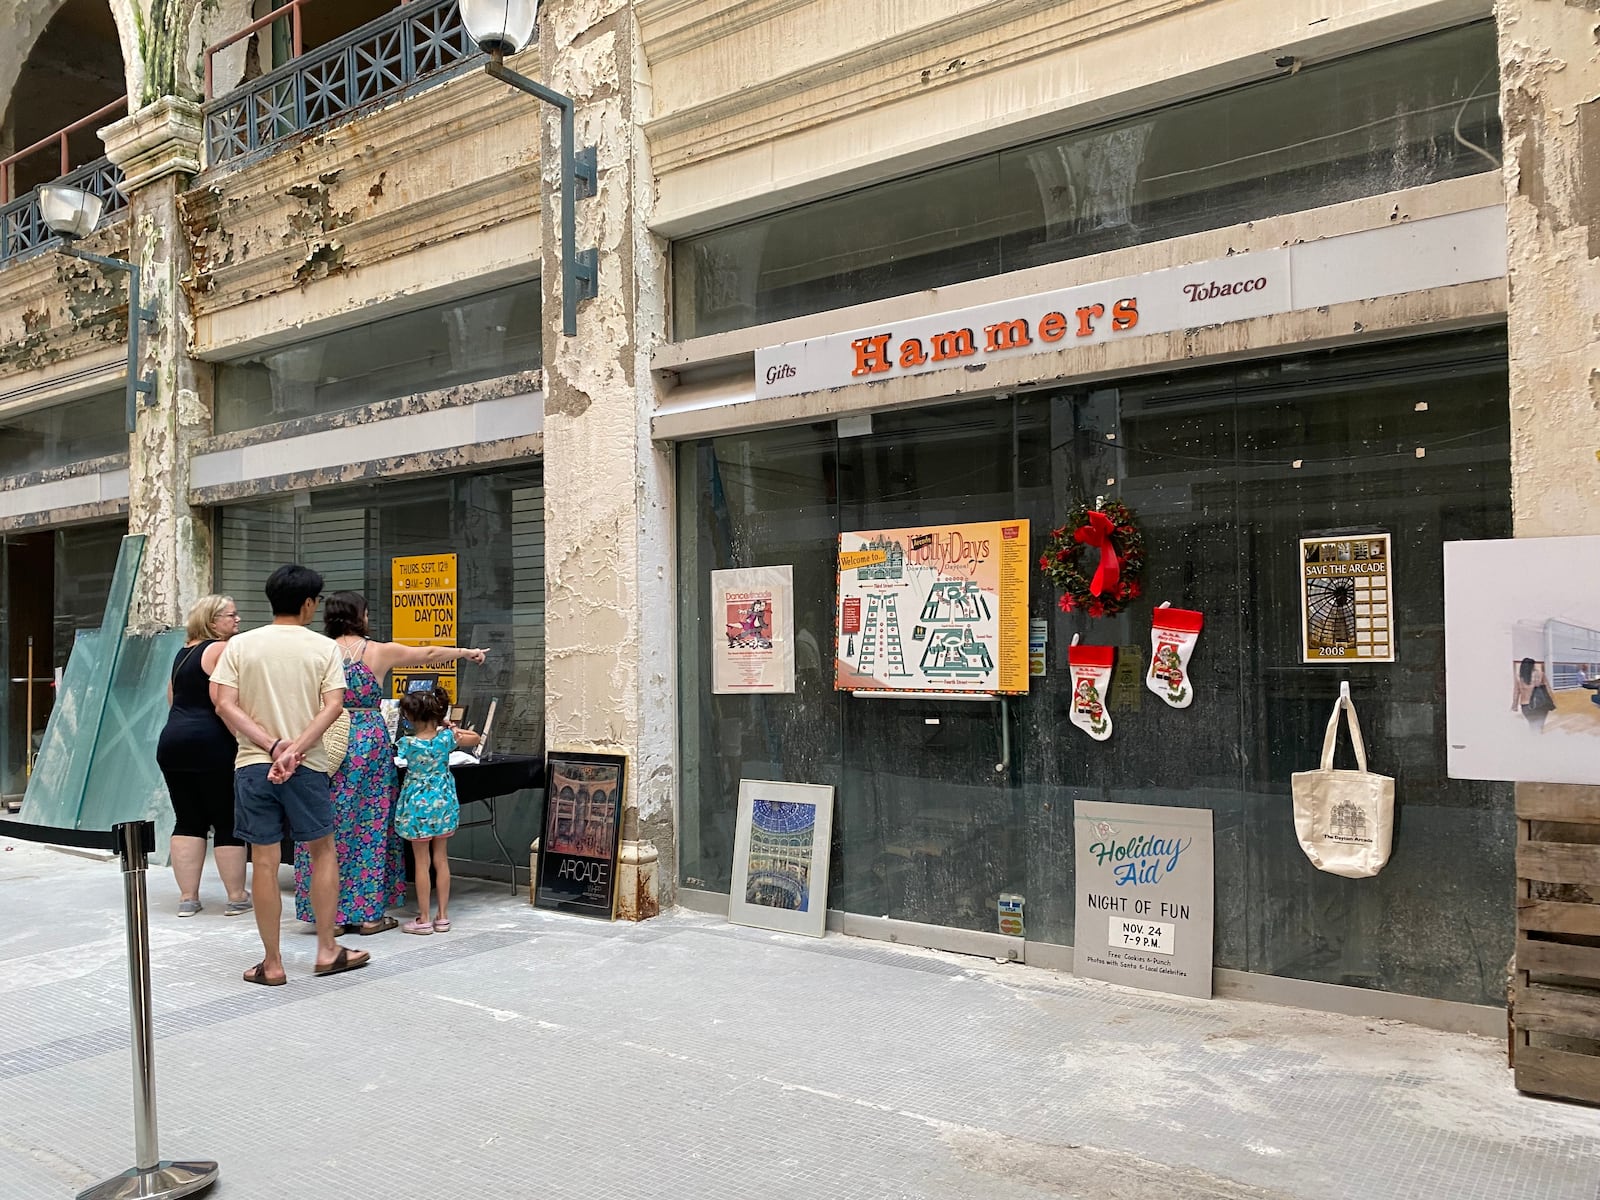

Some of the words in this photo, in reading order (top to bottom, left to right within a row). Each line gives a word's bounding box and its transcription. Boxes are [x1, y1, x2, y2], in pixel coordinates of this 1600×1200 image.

[1183, 276, 1267, 302] Tobacco
[851, 297, 1140, 377] Hammers
[766, 363, 797, 384] Gifts
[840, 555, 870, 566] Welcome
[1306, 565, 1328, 576] SAVE
[1329, 564, 1347, 574] THE
[1348, 562, 1386, 573] ARCADE
[394, 592, 454, 608] DOWNTOWN
[414, 608, 453, 622] DAYTON
[434, 623, 453, 638] DAY
[1319, 646, 1345, 656] 2008
[1089, 834, 1192, 873] Holiday
[557, 858, 609, 885] ARCADE
[1113, 858, 1164, 887] Aid
[1088, 893, 1128, 913] NIGHT
[1134, 899, 1152, 915] OF
[1160, 902, 1190, 920] FUN
[1122, 922, 1144, 935] NOV.
[1148, 926, 1162, 937] 24
[1123, 934, 1141, 946] 7-9
[1143, 937, 1161, 949] P.M.
[1087, 956, 1105, 965] Photos
[1106, 959, 1119, 967] with
[1120, 961, 1137, 970] Santa
[1145, 964, 1159, 973] Local
[1159, 966, 1187, 977] Celebrities
[1108, 950, 1121, 959] Free
[1124, 953, 1146, 963] Cookies
[1153, 957, 1172, 967] Punch
